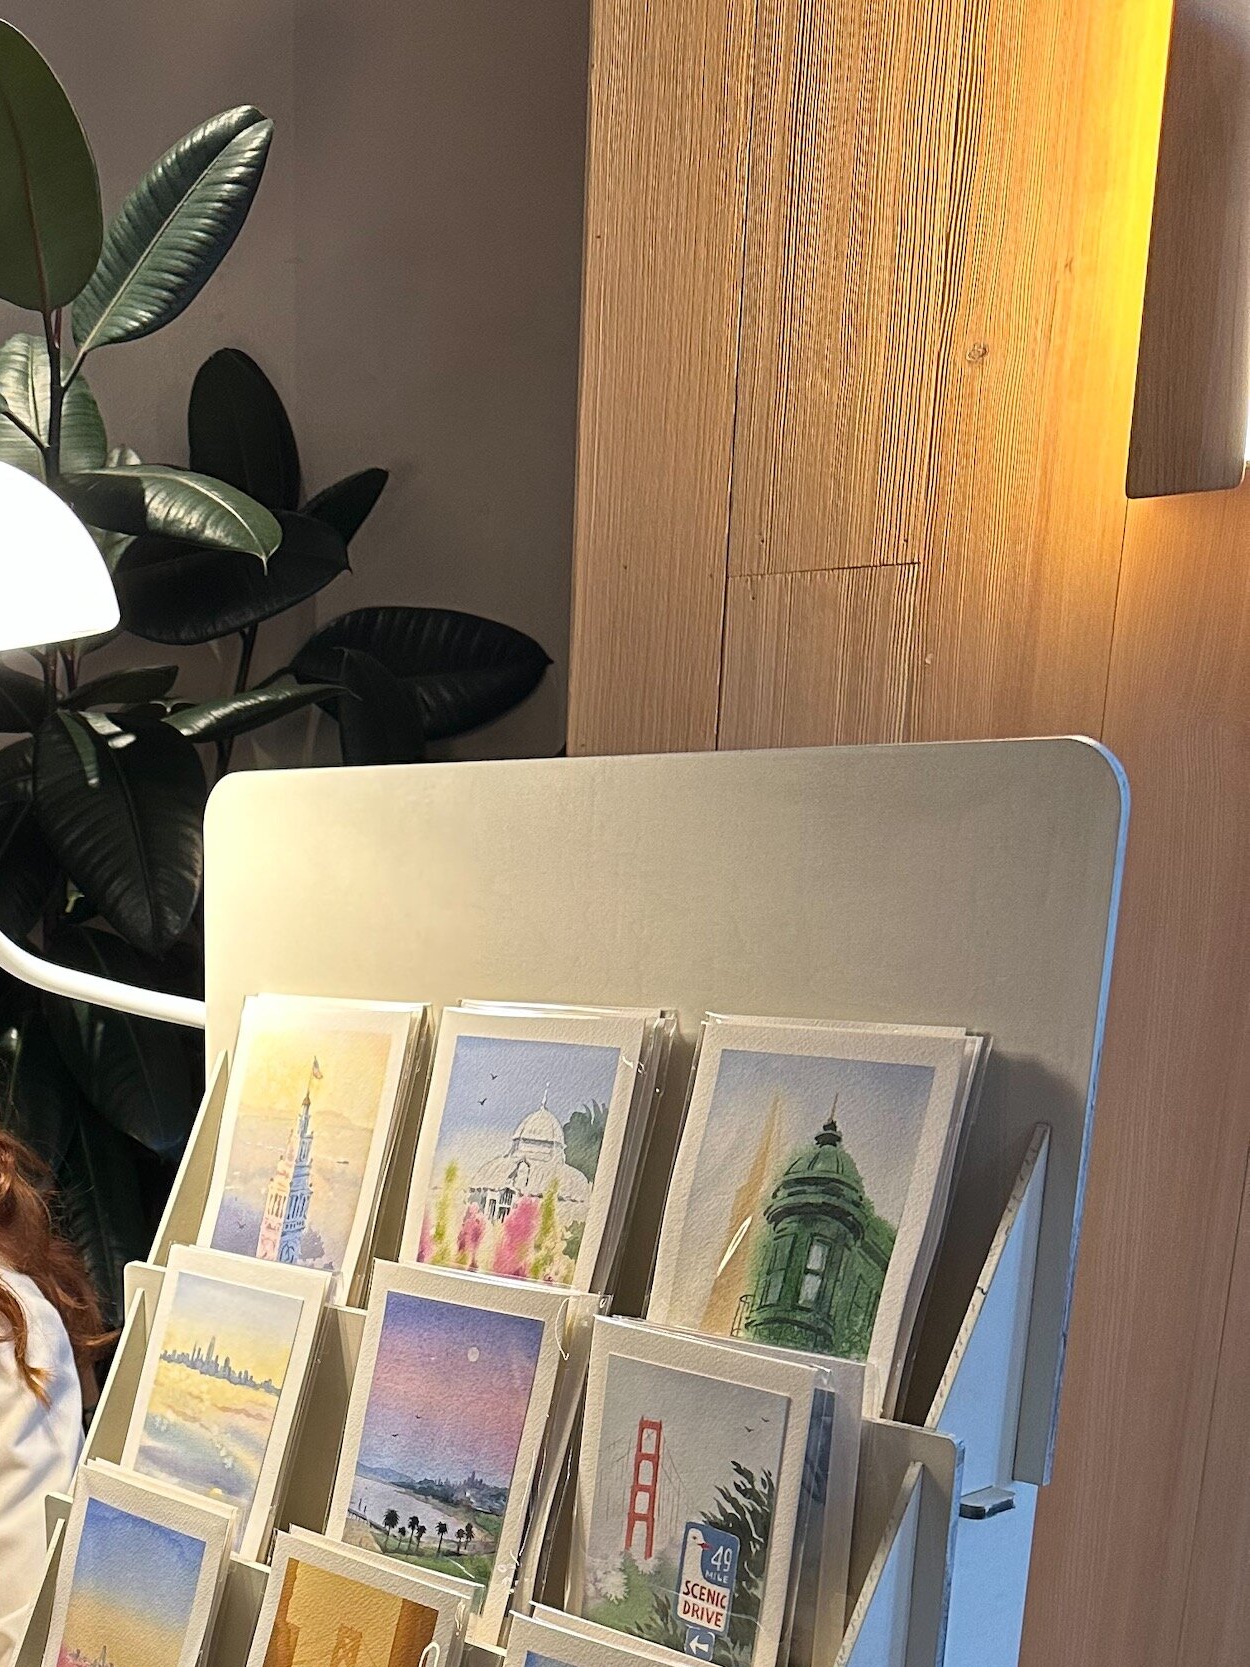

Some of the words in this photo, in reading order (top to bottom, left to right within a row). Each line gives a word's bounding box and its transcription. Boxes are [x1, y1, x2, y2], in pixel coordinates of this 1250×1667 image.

[711, 1545, 733, 1572] 49
[705, 1569, 729, 1584] MILE
[682, 1580, 727, 1609] SCENIC
[682, 1600, 723, 1627] DRIVE
